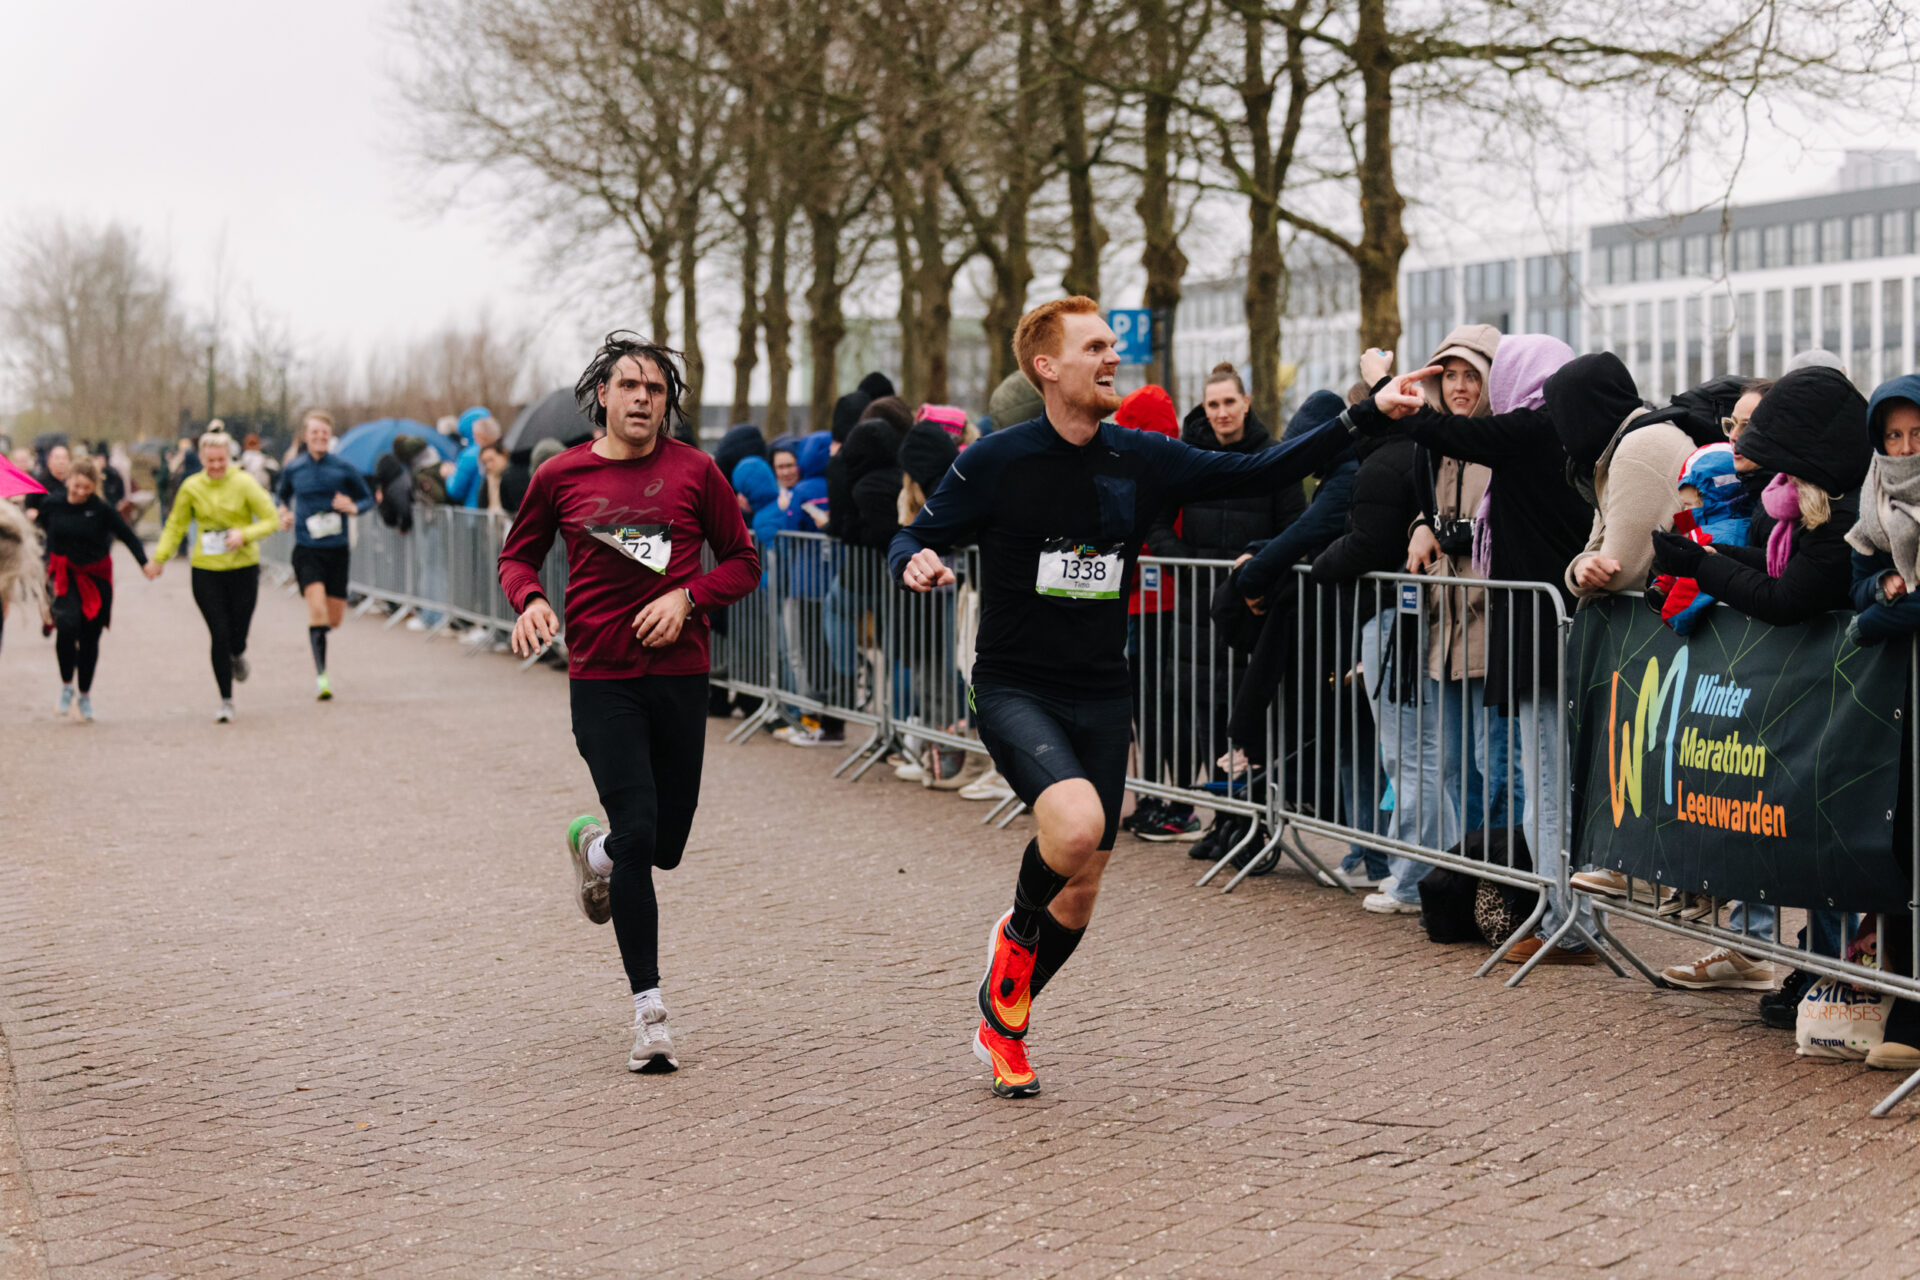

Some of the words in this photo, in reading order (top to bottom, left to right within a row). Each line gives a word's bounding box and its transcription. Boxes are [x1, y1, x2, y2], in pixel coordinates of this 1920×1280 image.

[620, 542, 652, 559] 72
[1061, 559, 1106, 580] 1338
[1691, 674, 1751, 718] Winter
[1679, 726, 1766, 778] Marathon
[1677, 780, 1787, 838] Leeuwarden
[1804, 1003, 1882, 1021] SURPRISES
[1810, 1037, 1846, 1048] ACTION
